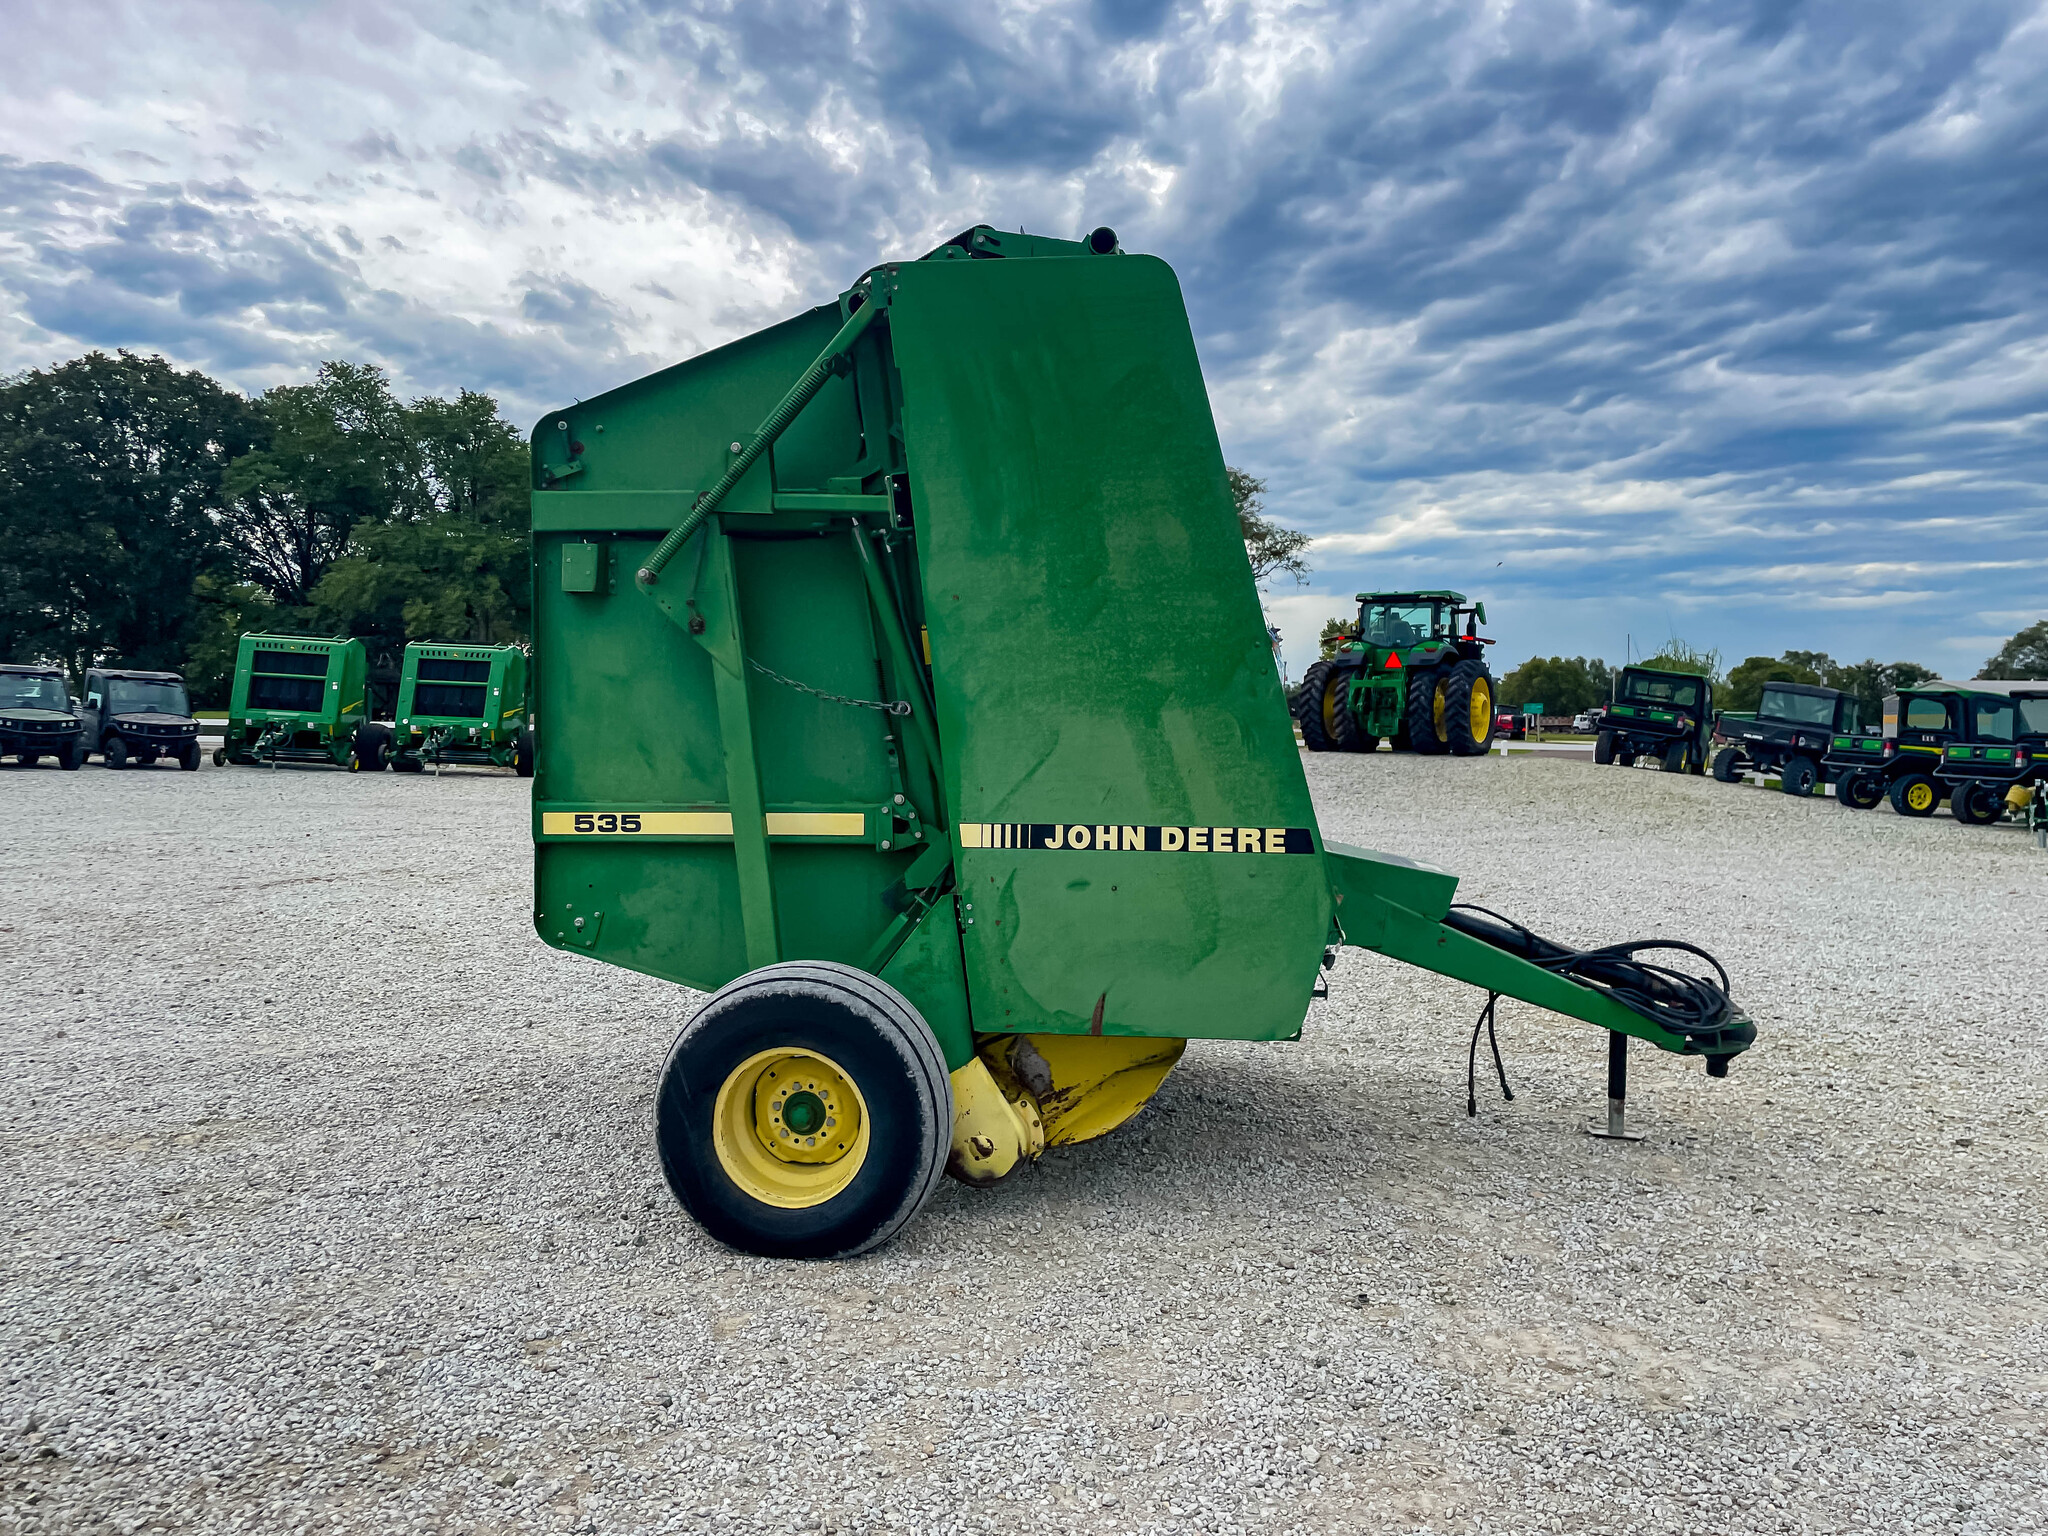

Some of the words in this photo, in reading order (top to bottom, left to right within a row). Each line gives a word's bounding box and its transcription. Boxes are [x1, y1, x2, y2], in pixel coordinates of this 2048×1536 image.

[574, 814, 642, 833] 535
[1044, 824, 1146, 851] JOHN
[1160, 826, 1287, 854] DEERE
